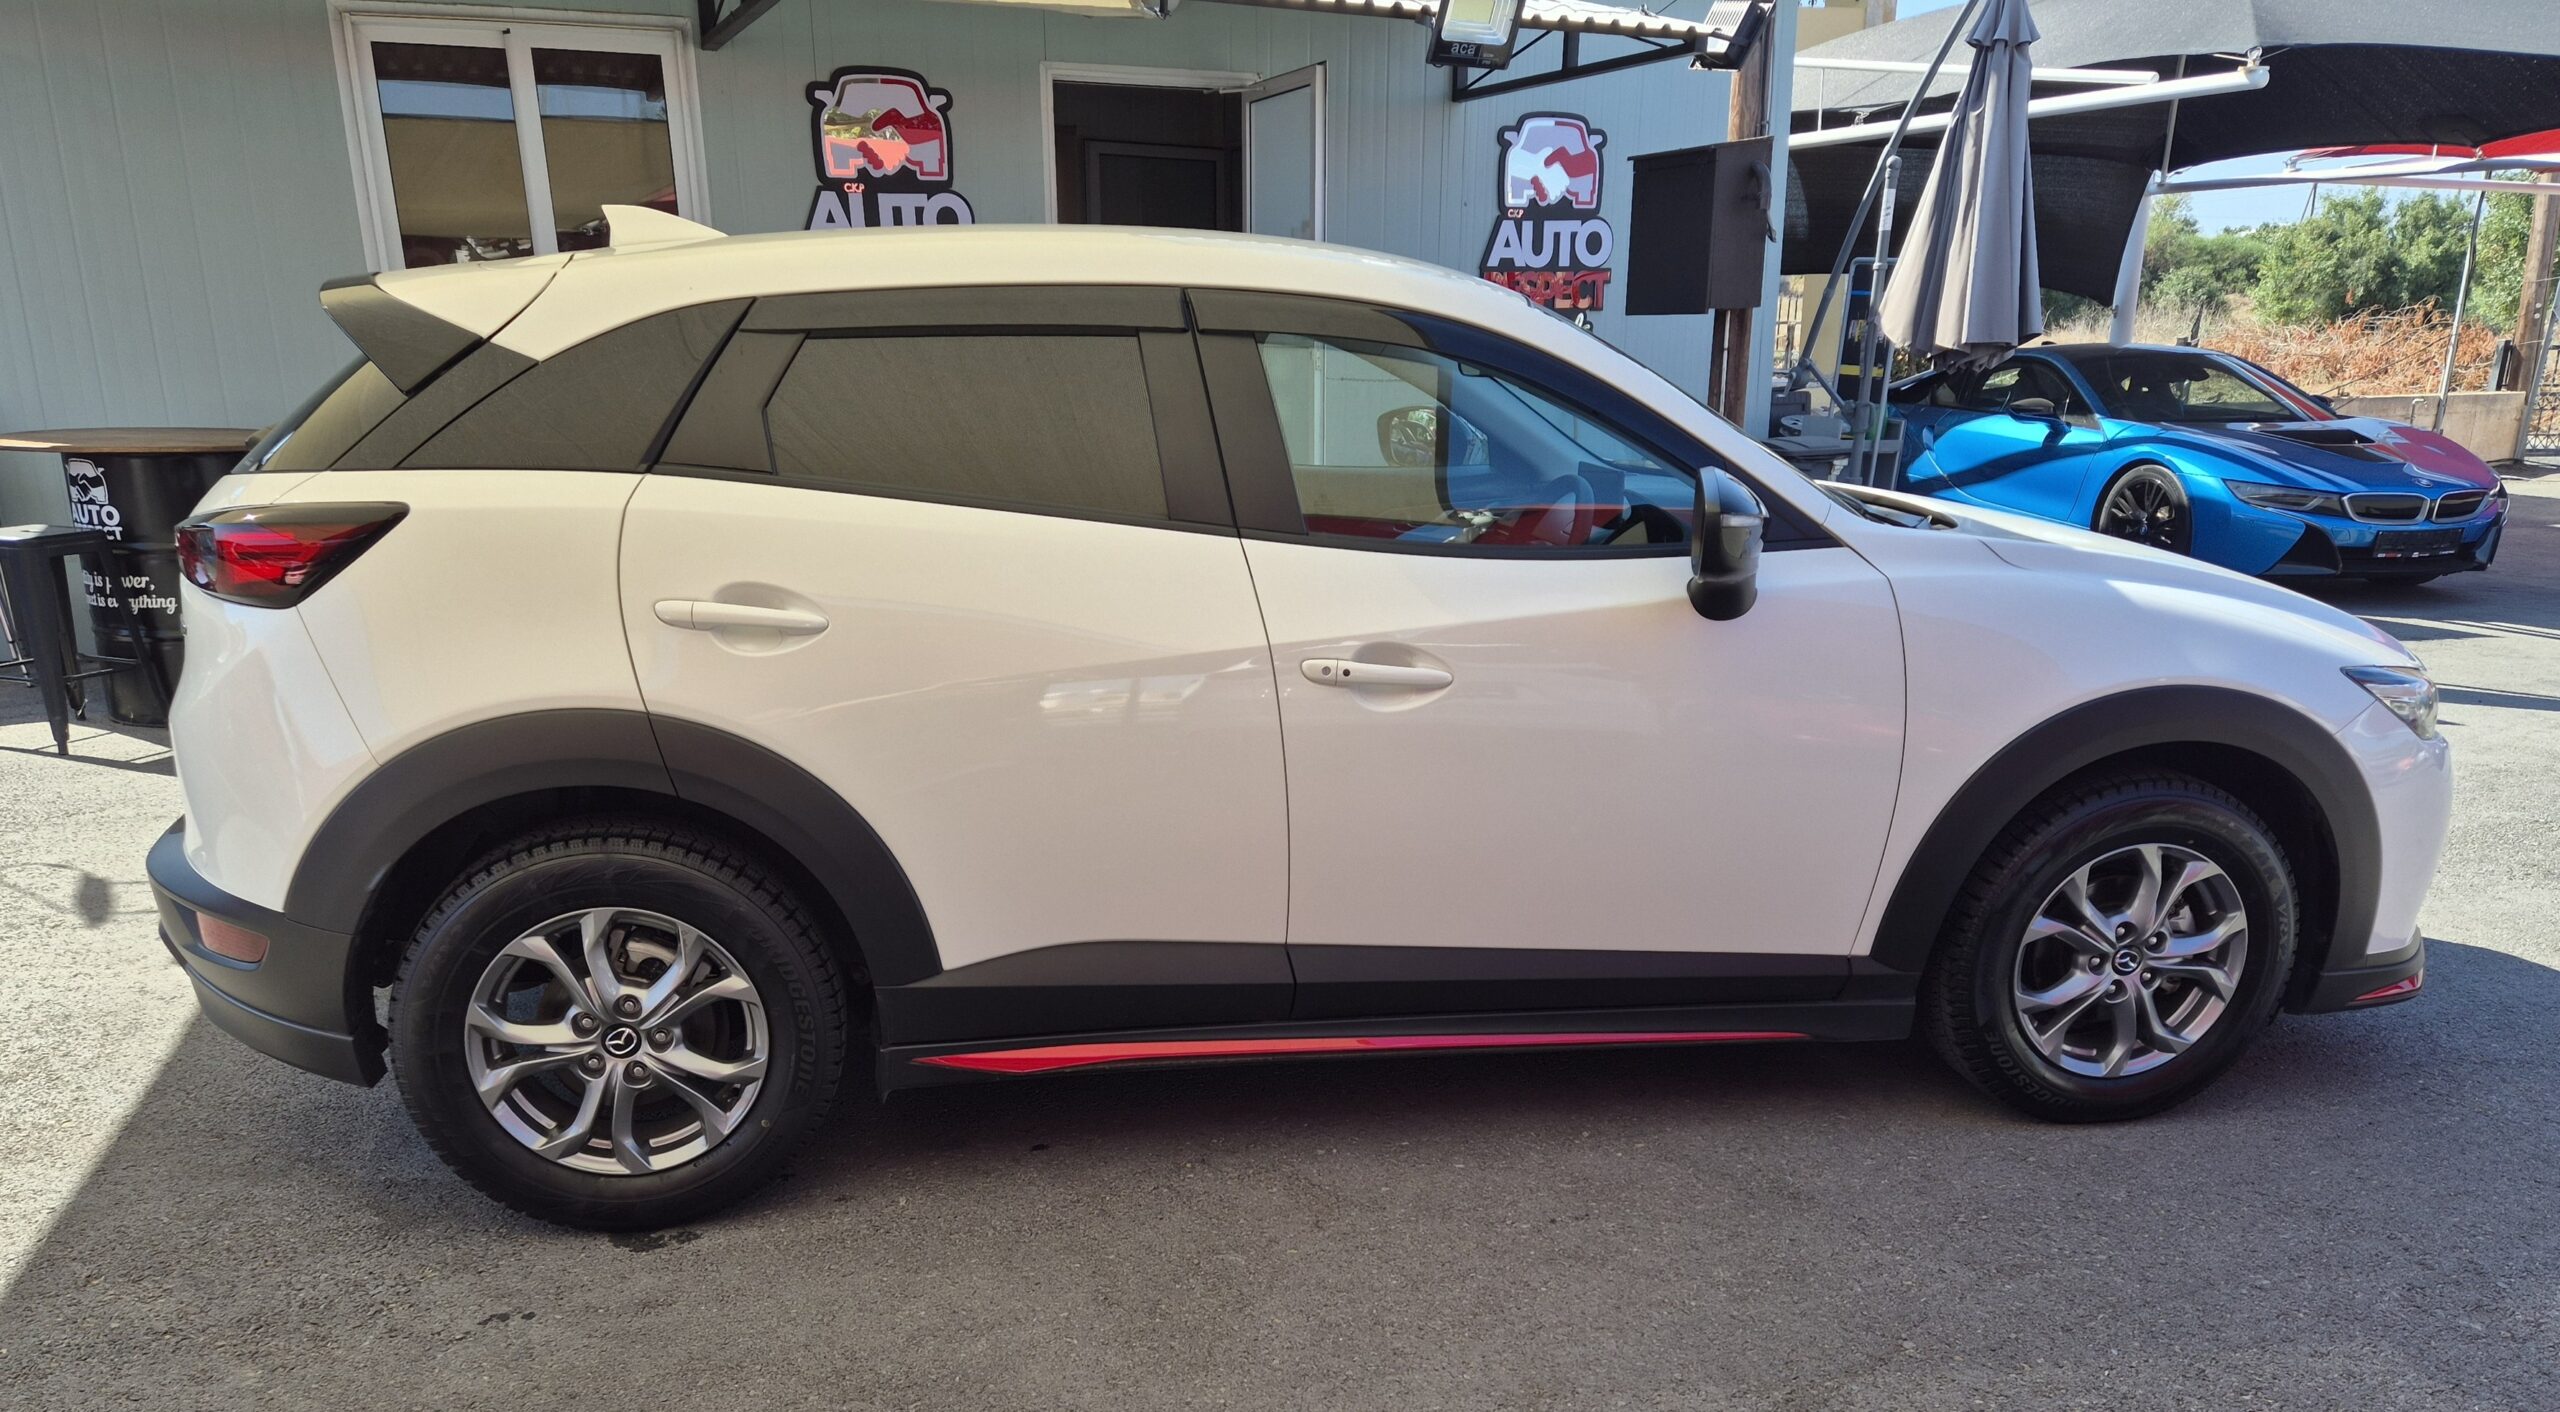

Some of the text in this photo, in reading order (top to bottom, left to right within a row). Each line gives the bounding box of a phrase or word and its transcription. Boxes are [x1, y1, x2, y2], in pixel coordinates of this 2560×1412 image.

[1451, 43, 1477, 54] aca
[810, 190, 972, 231] AUTO
[1487, 219, 1613, 268] AUTO
[72, 503, 120, 526] AUTO
